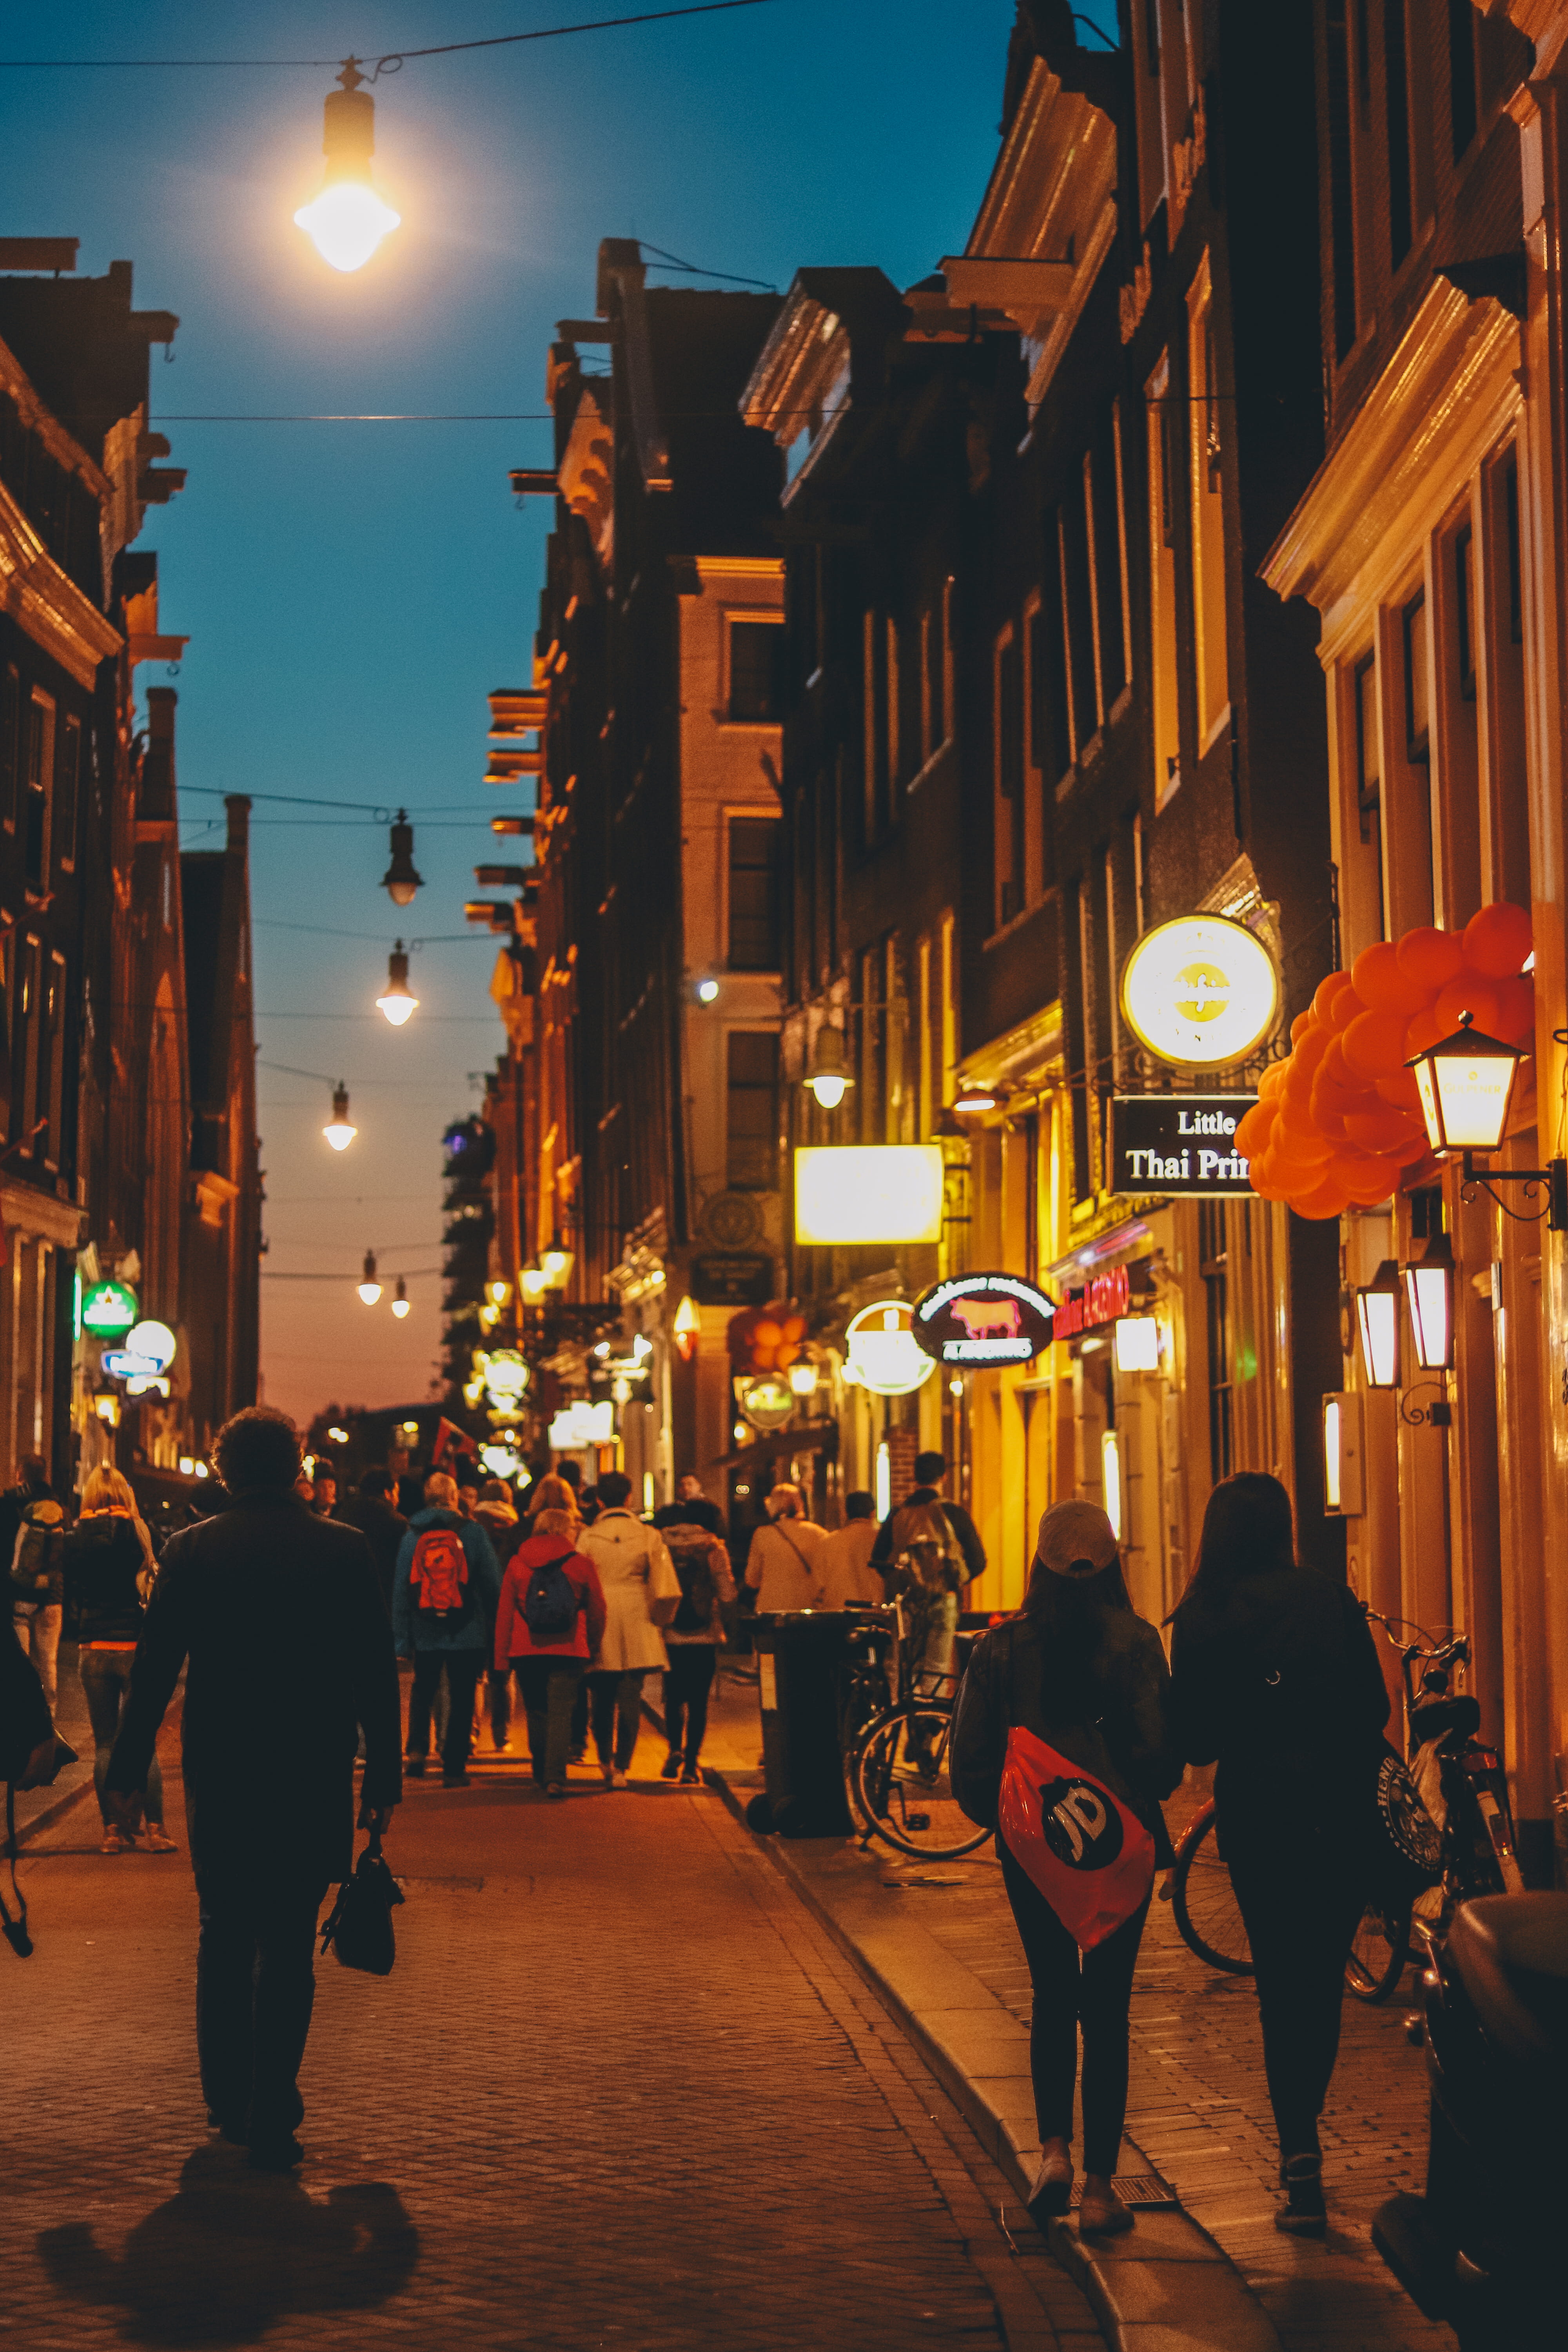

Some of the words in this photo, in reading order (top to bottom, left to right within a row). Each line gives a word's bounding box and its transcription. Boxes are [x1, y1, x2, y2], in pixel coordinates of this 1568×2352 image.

[1443, 1083, 1501, 1094] GULPENER
[1177, 1110, 1236, 1135] Little
[1125, 1148, 1190, 1180] Thai
[1052, 1786, 1107, 1862] JD
